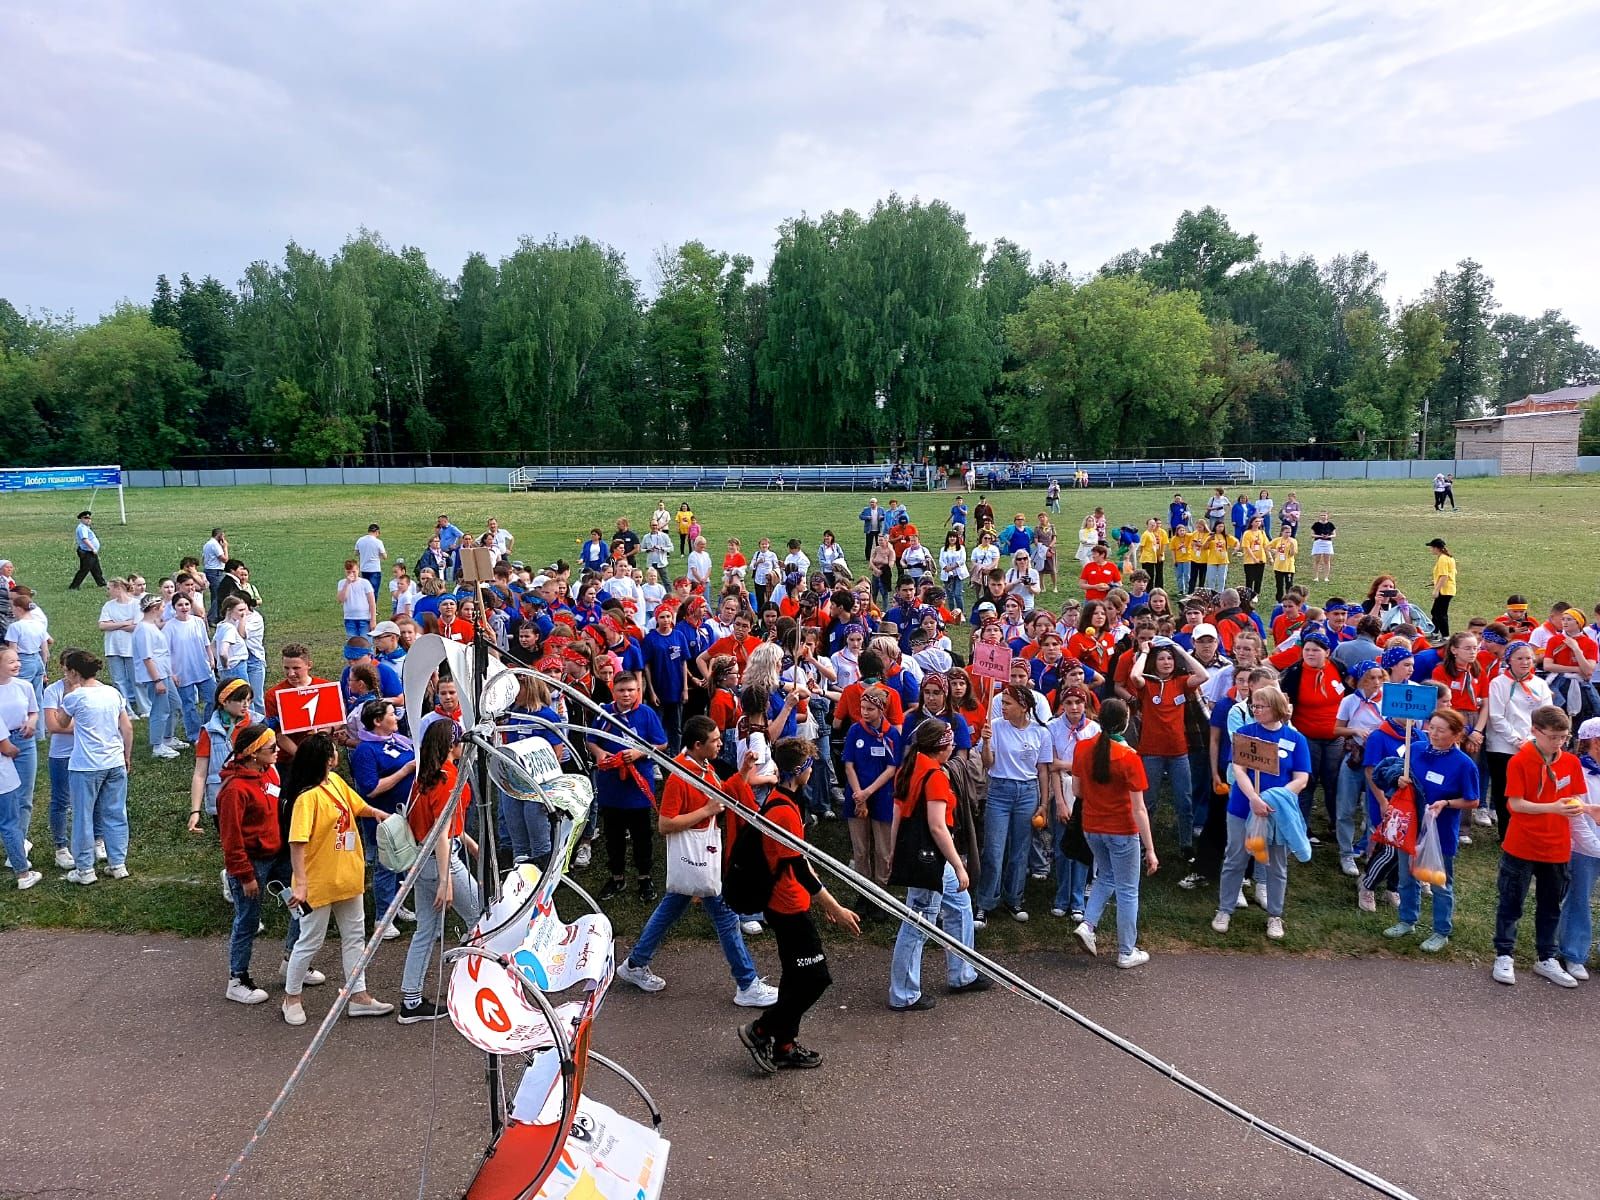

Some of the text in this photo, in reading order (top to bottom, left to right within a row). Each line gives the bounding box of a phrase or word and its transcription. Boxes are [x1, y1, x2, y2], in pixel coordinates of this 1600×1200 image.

[24, 476, 47, 486] Добро
[989, 649, 995, 662] 4
[979, 660, 1004, 671] отряд
[1405, 689, 1413, 702] 6
[1391, 702, 1428, 712] отряд
[1250, 741, 1257, 754] 5
[1240, 751, 1271, 765] отряд
